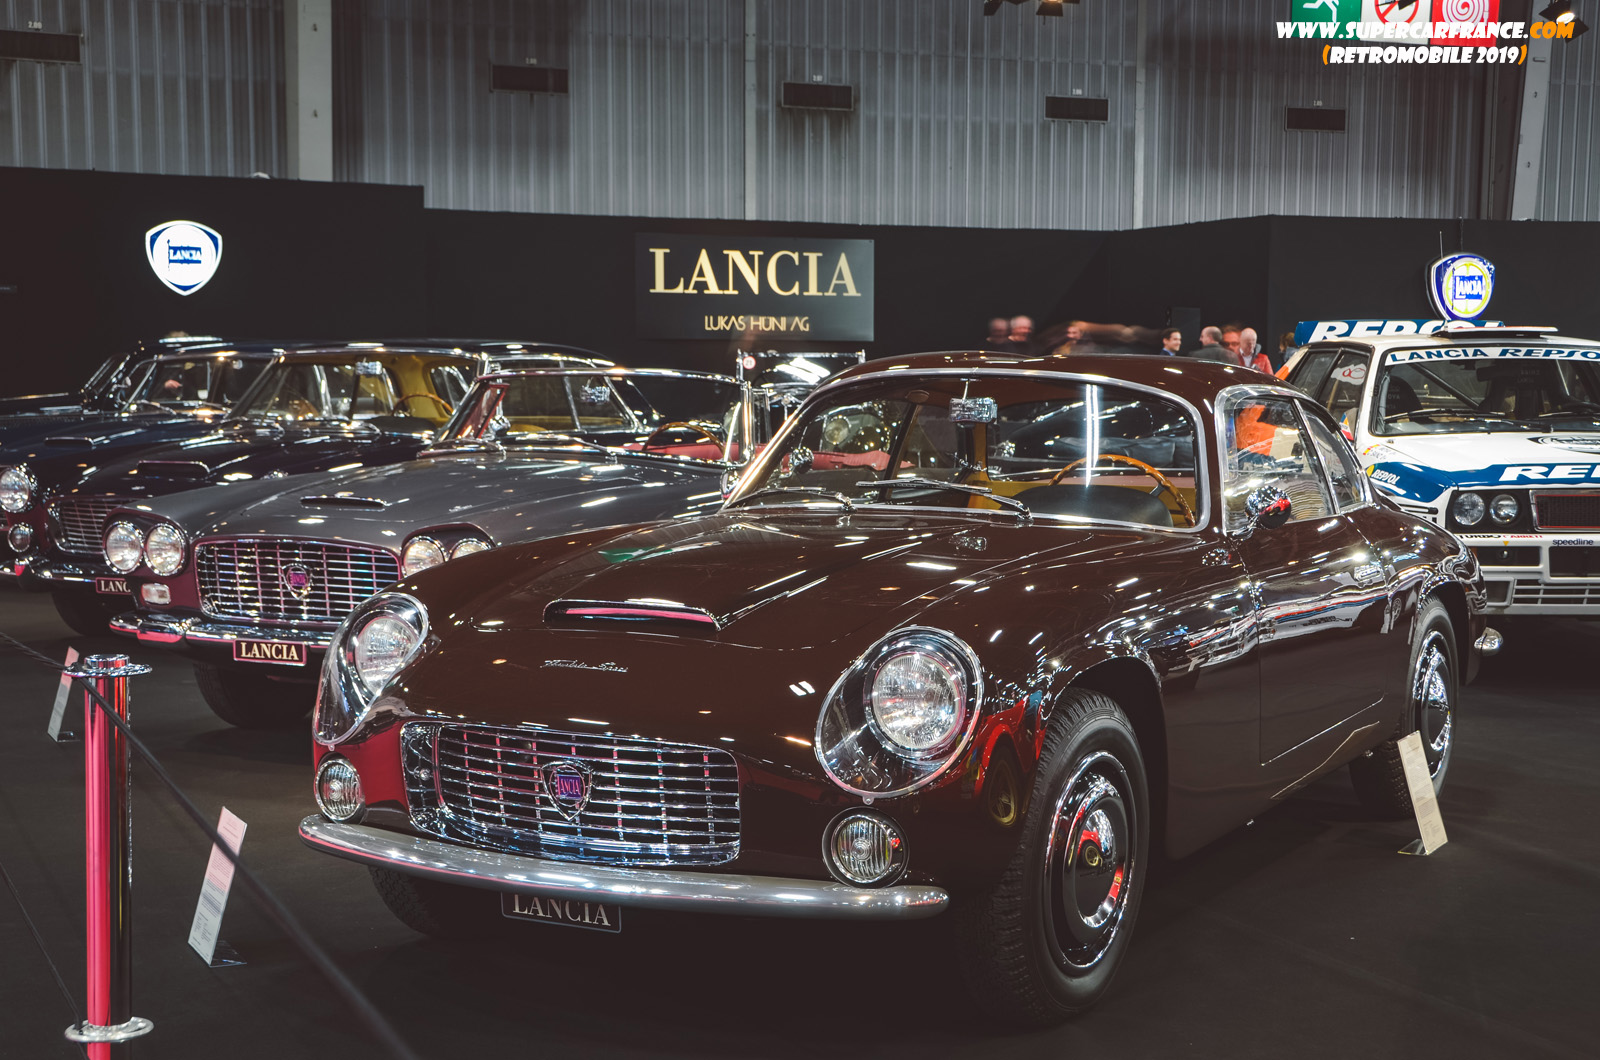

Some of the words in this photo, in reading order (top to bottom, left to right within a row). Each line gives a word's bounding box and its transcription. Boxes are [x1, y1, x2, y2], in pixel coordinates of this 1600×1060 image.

[169, 249, 202, 260] LANCIA
[649, 248, 861, 296] LANCIA
[704, 315, 745, 331] LUKAS
[790, 316, 809, 331] AG
[1390, 348, 1486, 362] LANCIA
[1498, 348, 1600, 359] REPSO
[1371, 469, 1400, 484] REPSOL
[1498, 464, 1600, 482] RE
[1552, 538, 1594, 546] speedline
[240, 642, 299, 661] LANCIA
[512, 894, 611, 926] LANCIA
